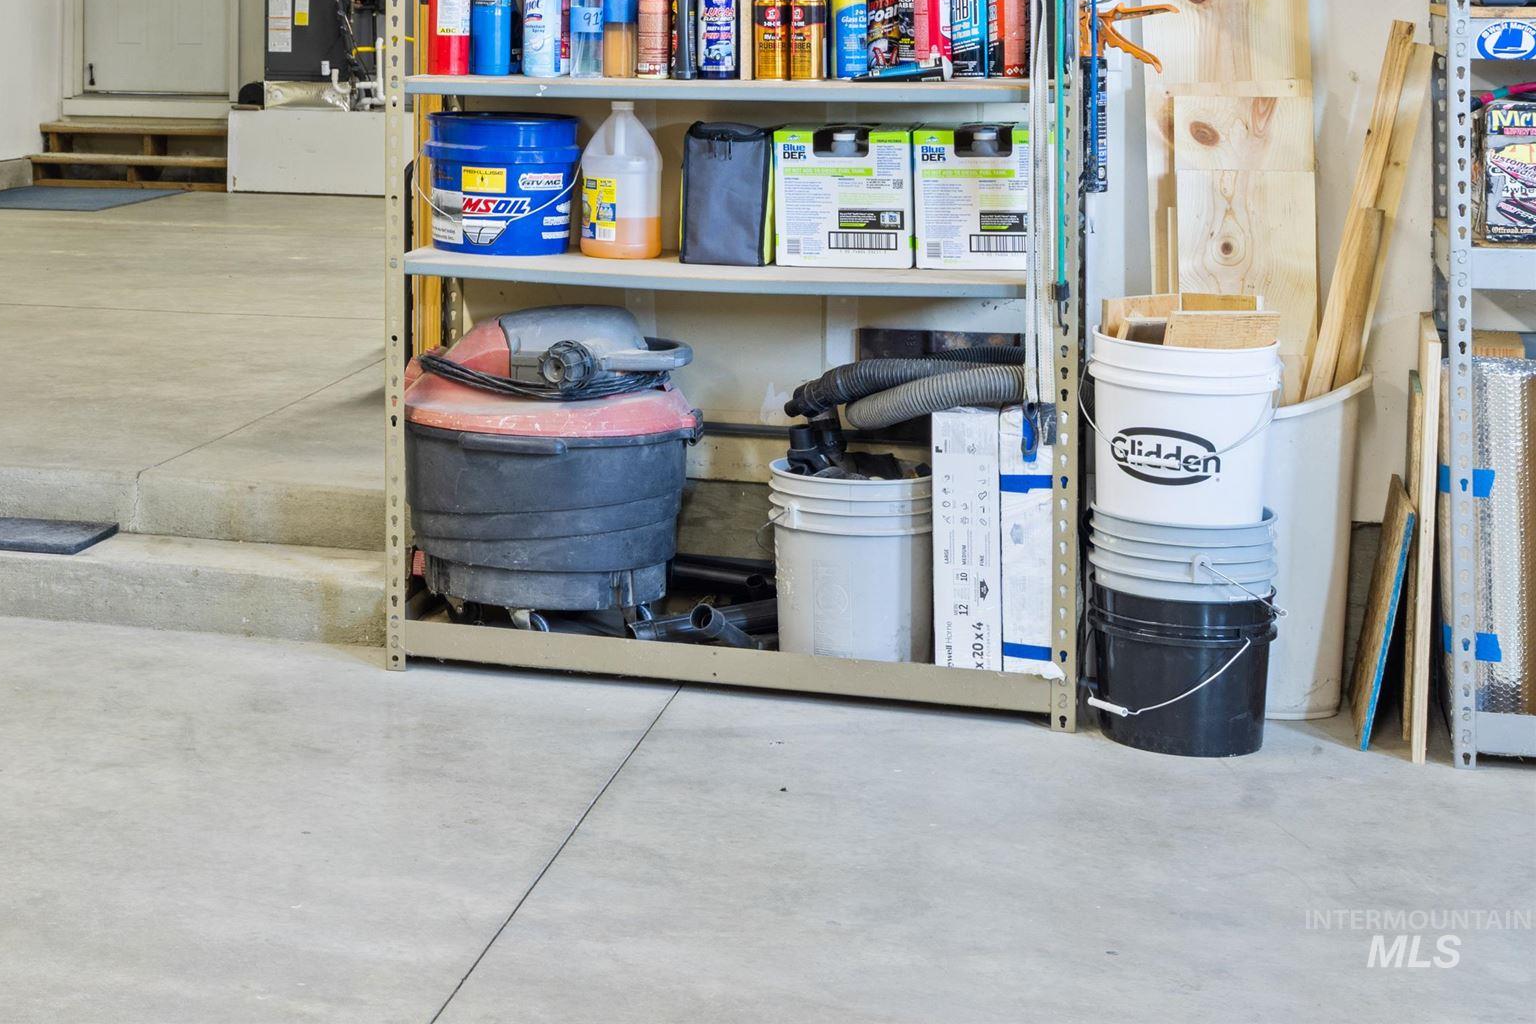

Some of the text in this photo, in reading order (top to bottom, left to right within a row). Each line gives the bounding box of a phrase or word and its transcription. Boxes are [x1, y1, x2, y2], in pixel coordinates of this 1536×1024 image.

[783, 143, 806, 151] Blue
[921, 145, 946, 154] Blue
[783, 151, 805, 160] DEF
[921, 153, 944, 162] DEF
[1503, 185, 1535, 194] 4whe
[1110, 432, 1221, 474] Glidden
[960, 572, 968, 582] 10
[959, 603, 969, 616] 12
[971, 621, 984, 631] 4
[944, 621, 953, 644] Home
